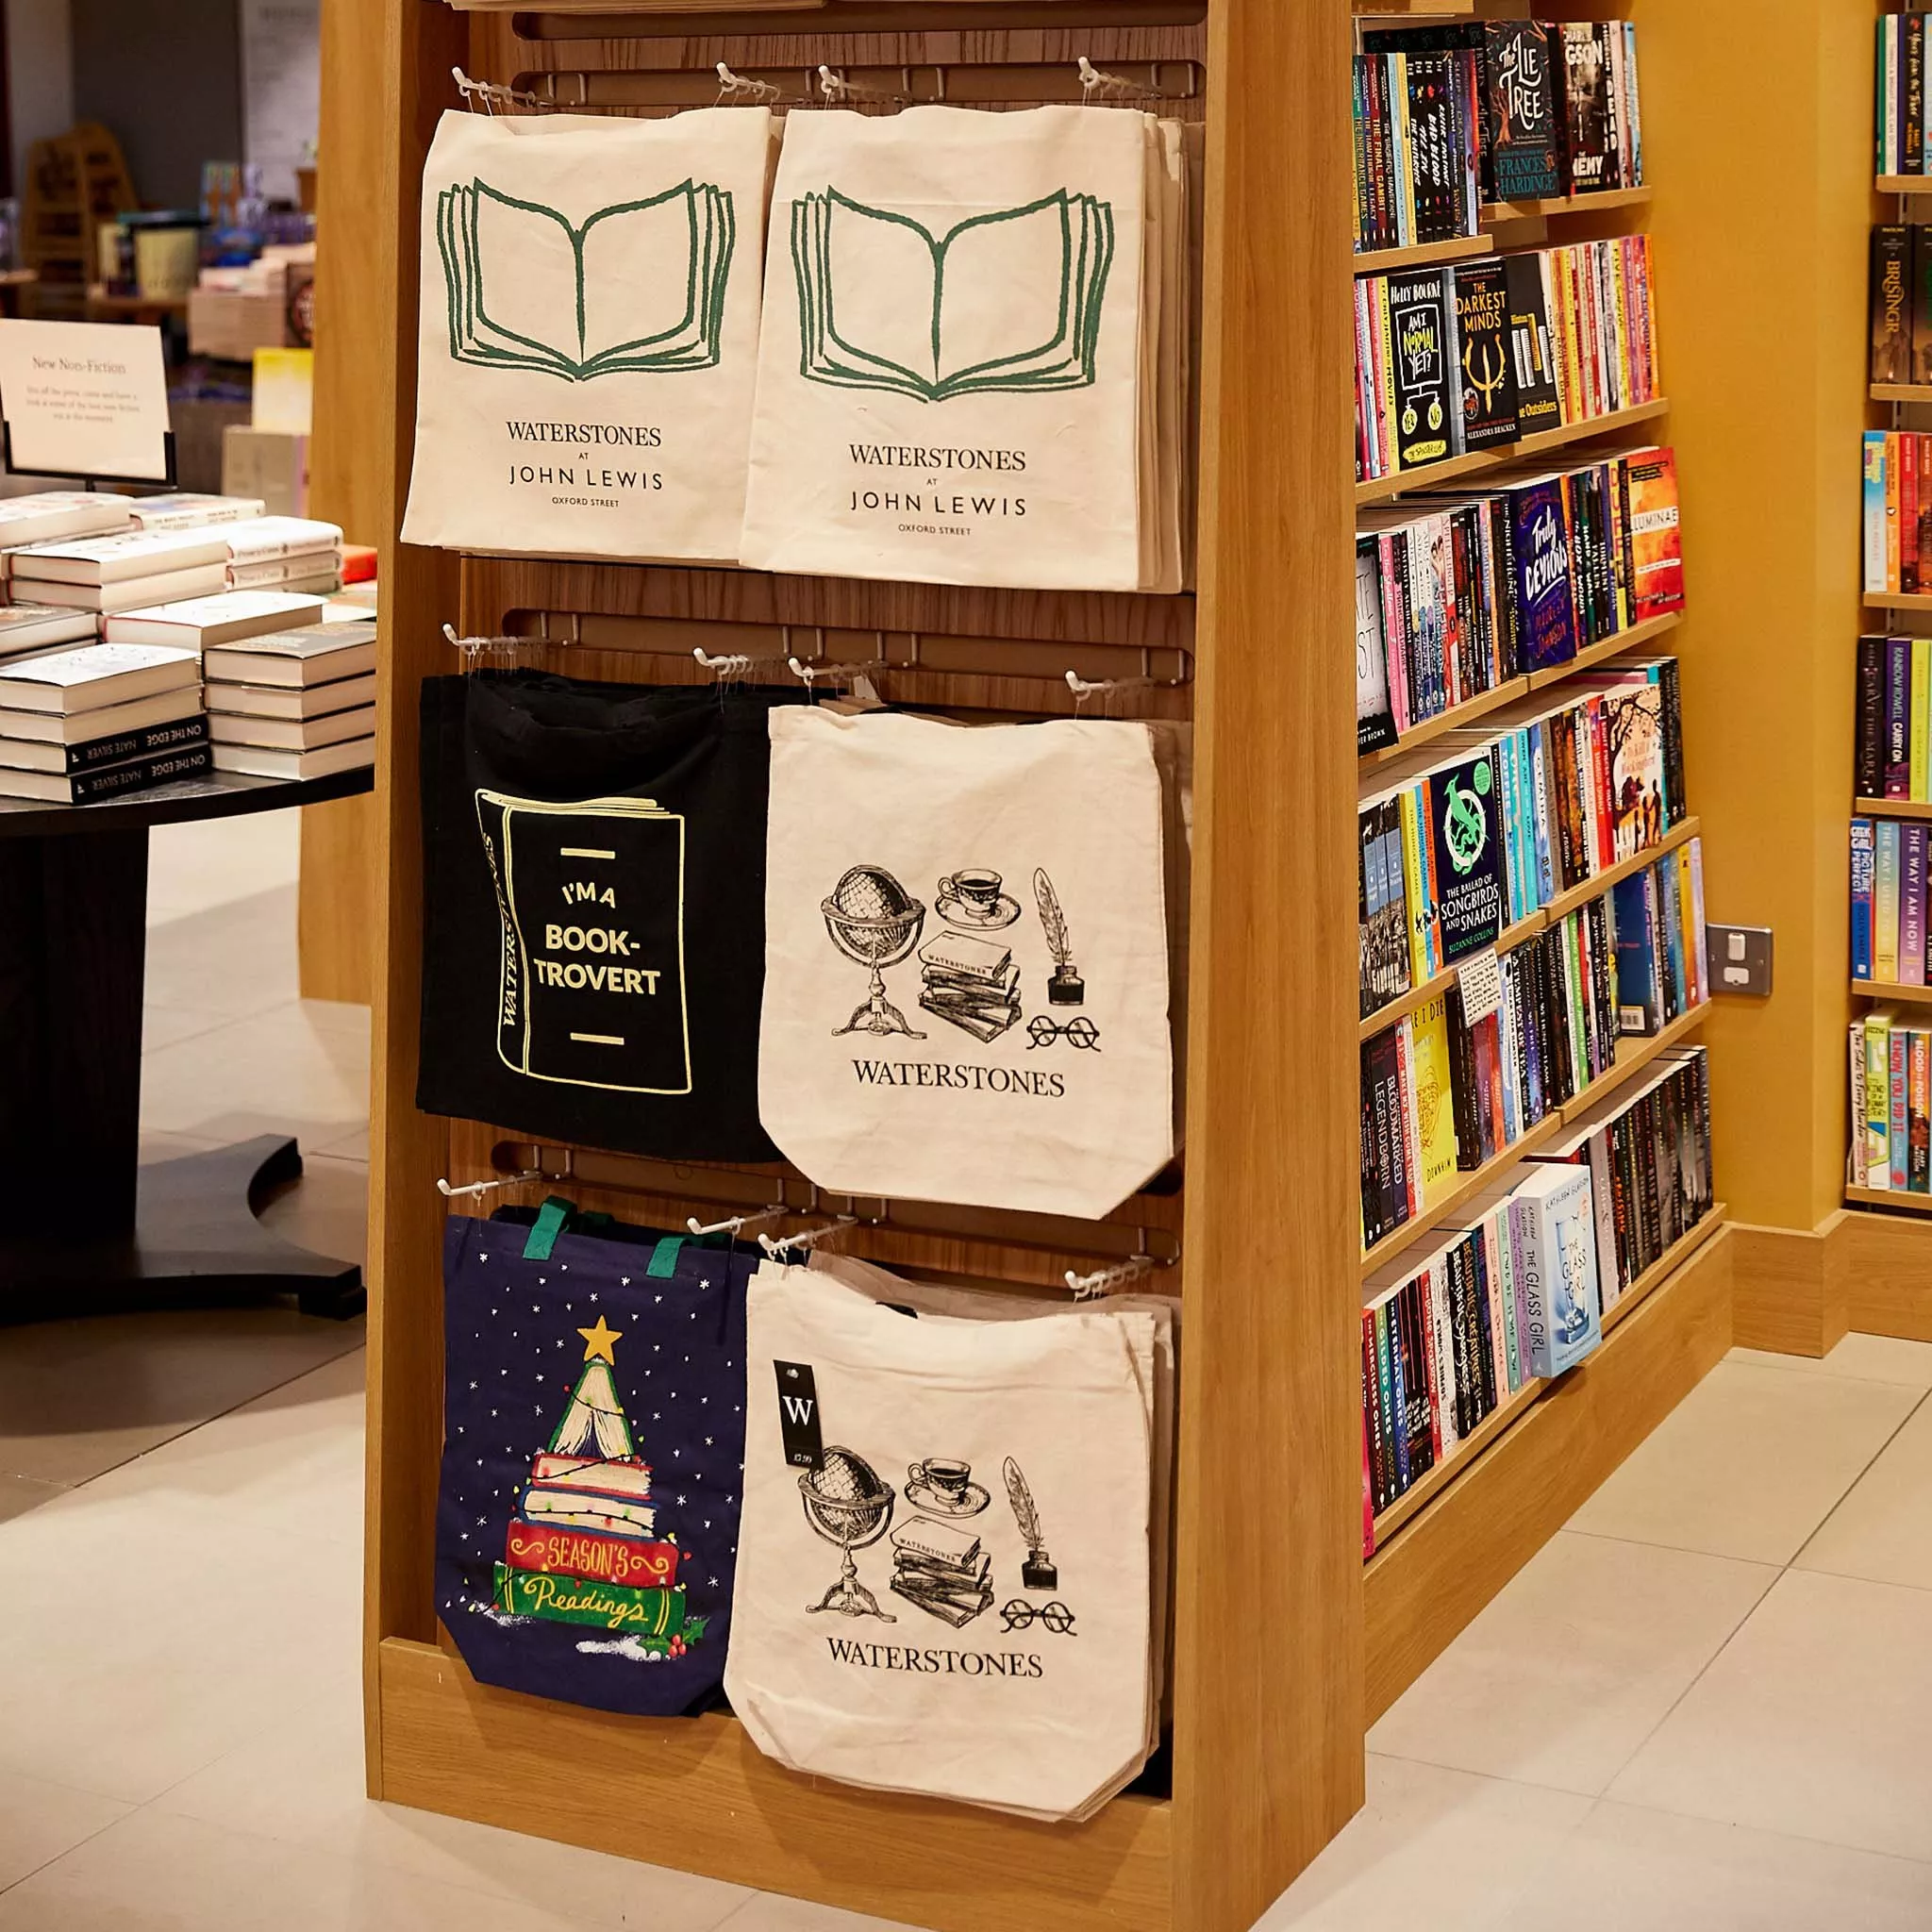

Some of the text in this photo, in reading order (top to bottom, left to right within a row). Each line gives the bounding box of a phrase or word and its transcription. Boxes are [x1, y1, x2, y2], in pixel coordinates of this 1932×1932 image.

[1513, 33, 1541, 87] LIE
[1499, 66, 1544, 130] TREE
[1373, 117, 1381, 137] THE
[1409, 118, 1418, 135] THE
[1374, 142, 1383, 171] FINAL
[1427, 114, 1441, 187] BAD BLOOD
[1499, 158, 1546, 176] FRANCES
[1376, 175, 1386, 211] GAMBIT
[1500, 172, 1557, 194] HARDINGE
[1359, 190, 1368, 219] GAMES
[1369, 188, 1377, 220] LEGACY
[1391, 285, 1412, 305] HOLLY
[1474, 282, 1486, 293] THE
[1882, 260, 1905, 332] BRISINGR
[1457, 291, 1507, 316] DARKEST
[1465, 310, 1503, 332] MINDS
[1403, 326, 1439, 356] NORMAL
[32, 356, 126, 375] New Non-Fiction
[1408, 350, 1431, 381] YET?
[1525, 399, 1557, 417] Outsiders
[506, 421, 661, 447] WATERSTONES
[578, 452, 589, 460] AT
[849, 443, 1026, 471] WATERSTONES
[509, 465, 662, 491] JOHN LEWIS
[552, 496, 619, 508] OXFORD STREET
[851, 491, 1026, 516] JOHN LEWIS
[1611, 468, 1623, 557] DUFF
[898, 524, 972, 537] OXFORD STREET
[1532, 506, 1557, 555] Truly
[1583, 525, 1592, 558] HAND
[1525, 540, 1567, 601] DEVIOUS
[1591, 544, 1601, 590] FALLEN
[1866, 672, 1881, 714] CARVE
[1891, 647, 1904, 762] RAINBOW ROWELL CARRY ON
[87, 740, 137, 760] NATE SILVER
[146, 724, 202, 747] ON THE EDGE
[1367, 728, 1386, 744] BROWN
[151, 755, 206, 777] ON THE EDGE
[1861, 741, 1875, 777] MARK
[92, 770, 142, 791] NATE SILVER
[1502, 748, 1510, 810] TOFFEE
[1908, 829, 1920, 853] THE
[1852, 851, 1861, 892] PERFECT
[1861, 851, 1870, 892] PICTURE
[1908, 858, 1919, 884] WAY
[561, 882, 616, 908] I'M A
[1446, 873, 1492, 899] THE BALLAD OF
[1441, 883, 1499, 921] SONGBIRDS
[1907, 896, 1918, 916] AM
[1445, 903, 1497, 932] AND SNAKES
[545, 924, 641, 956] BOOK-
[1448, 927, 1494, 955] SUZANNE COLLINS
[1907, 920, 1918, 951] NOW
[533, 958, 660, 995] TROVERT
[927, 953, 988, 976] WATERSTONES
[1422, 997, 1444, 1025] I DIE
[1512, 956, 1527, 1078] A TEMPEST OF TEA
[1527, 1011, 1534, 1024] WE
[1540, 1002, 1546, 1017] WE
[1890, 1040, 1904, 1074] KNOW
[1915, 1040, 1924, 1072] BLOOD
[851, 1058, 1065, 1099] WATERSTONES
[1400, 1069, 1408, 1093] MAKE
[1891, 1077, 1904, 1098] YOU
[1402, 1096, 1409, 1108] MY
[1892, 1102, 1905, 1119] DID
[1915, 1080, 1924, 1118] POISON
[1374, 1080, 1391, 1190] LEGENDBORN
[1387, 1075, 1404, 1185] BLOODMARKED
[1893, 1123, 1905, 1132] IT
[1404, 1138, 1412, 1160] COME
[1545, 1189, 1571, 1210] KATHLEEN
[1452, 1251, 1465, 1316] BEAUTIFUL
[1463, 1241, 1481, 1383] BEAUTIFUL CREATURES
[1525, 1250, 1543, 1356] THE GLASS GIRL
[1379, 1327, 1389, 1385] GILDED
[1391, 1320, 1400, 1384] ETERNAL
[1425, 1298, 1437, 1394] BONE SPARROW
[1368, 1336, 1378, 1407] MERCILESS
[1373, 1409, 1381, 1449] ONES
[1395, 1387, 1404, 1426] ONES
[782, 1395, 814, 1426] W
[1383, 1390, 1391, 1435] ONES
[547, 1536, 629, 1577] SEASON'S
[898, 1537, 957, 1563] WATERSTONES
[524, 1576, 649, 1629] Readings
[826, 1637, 1043, 1678] WATERSTONES
